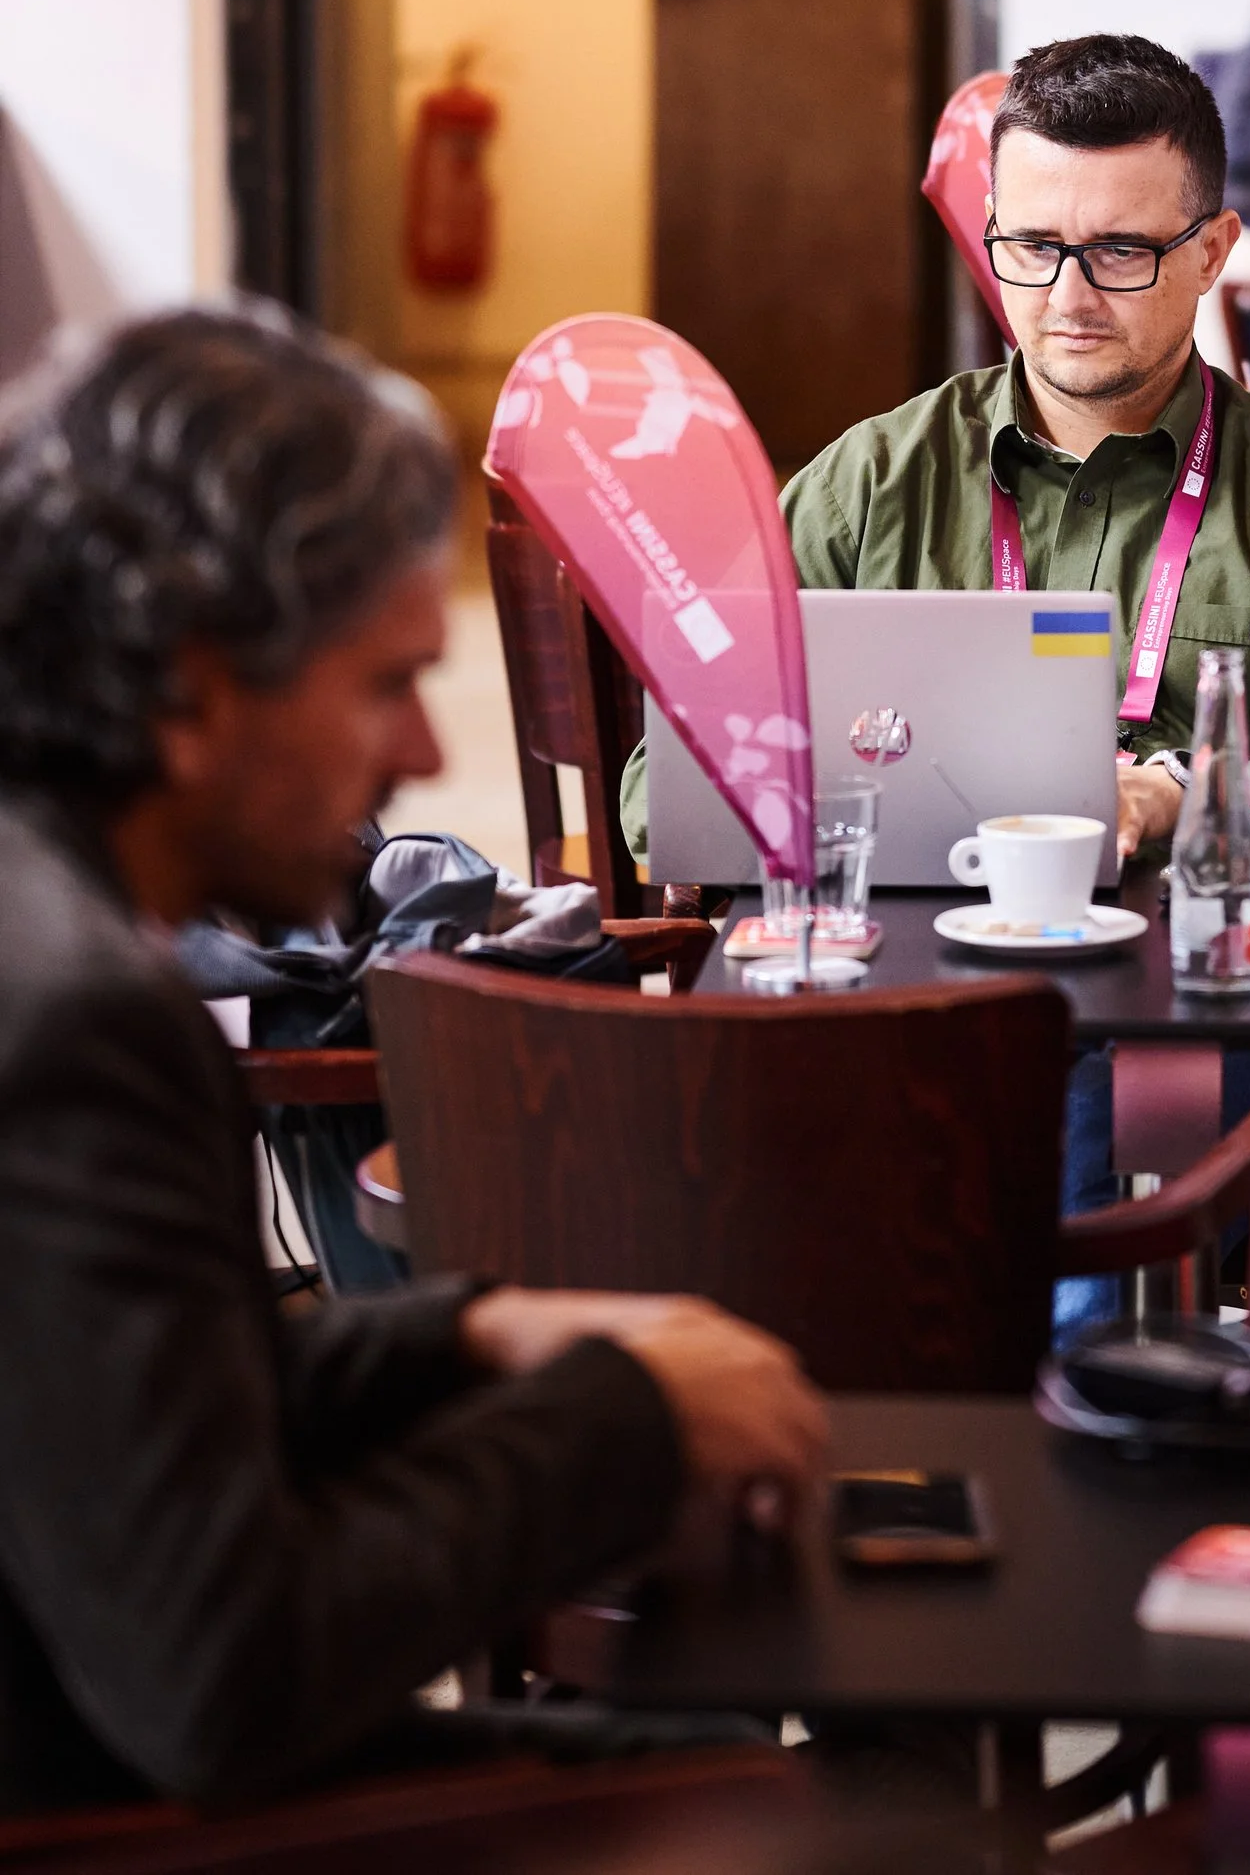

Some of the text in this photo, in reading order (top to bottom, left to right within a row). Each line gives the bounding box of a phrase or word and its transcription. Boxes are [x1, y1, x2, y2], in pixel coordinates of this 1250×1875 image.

[1192, 428, 1209, 470] CASSINI
[1002, 539, 1012, 583] #EUSpace
[1142, 562, 1171, 648] CASSINI #EUSpace
